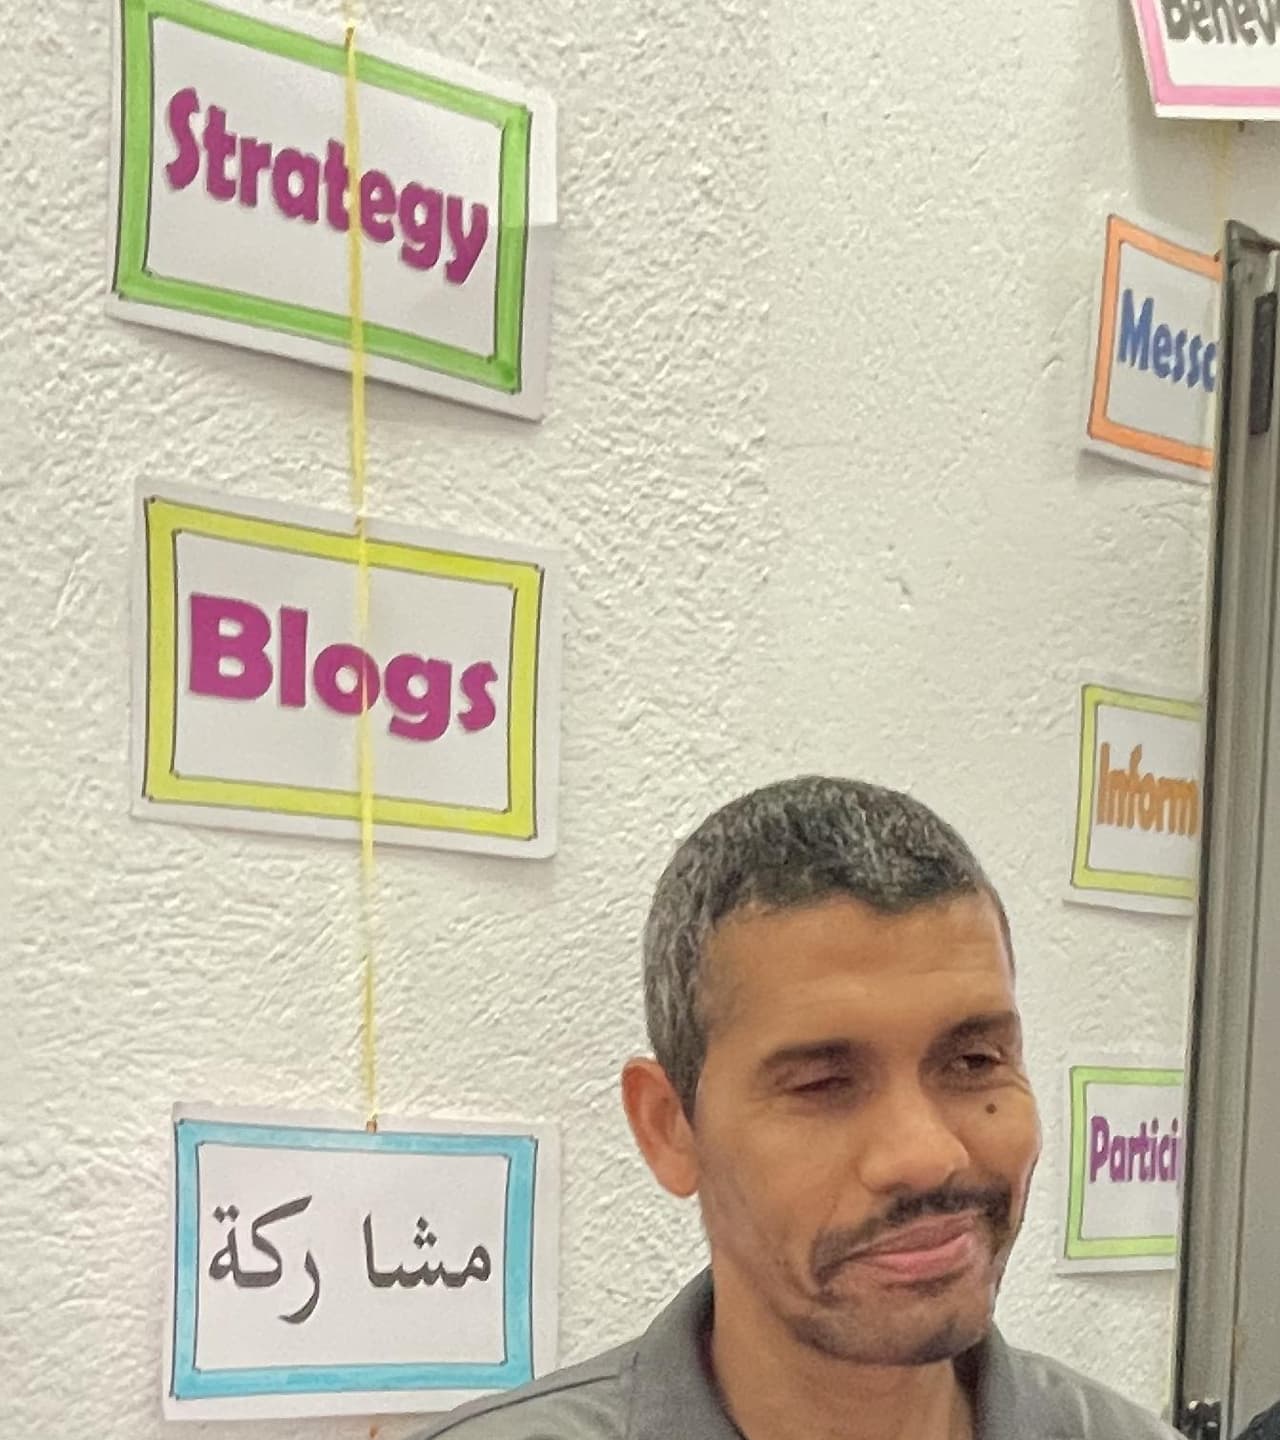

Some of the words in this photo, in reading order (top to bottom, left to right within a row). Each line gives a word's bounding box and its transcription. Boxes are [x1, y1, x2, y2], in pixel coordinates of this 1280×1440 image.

[165, 87, 488, 285] Strategy
[188, 591, 499, 742] Blogs
[1096, 741, 1198, 837] Inform
[1089, 1115, 1179, 1183] Partici
